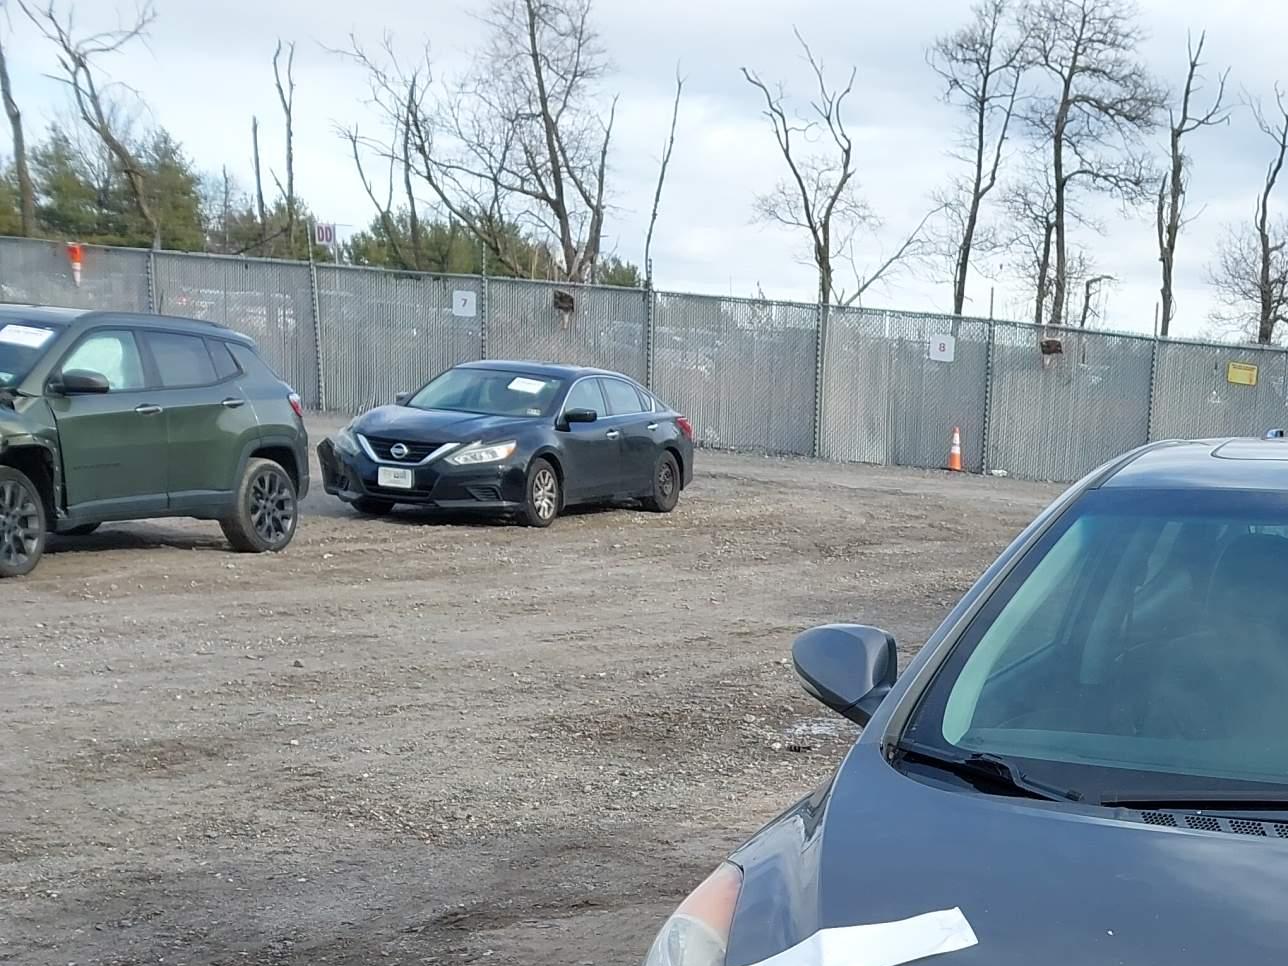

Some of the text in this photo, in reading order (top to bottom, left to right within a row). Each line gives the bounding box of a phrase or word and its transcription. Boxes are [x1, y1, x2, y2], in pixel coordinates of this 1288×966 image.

[317, 225, 332, 243] DD
[461, 297, 468, 308] 7
[938, 342, 946, 352] 8
